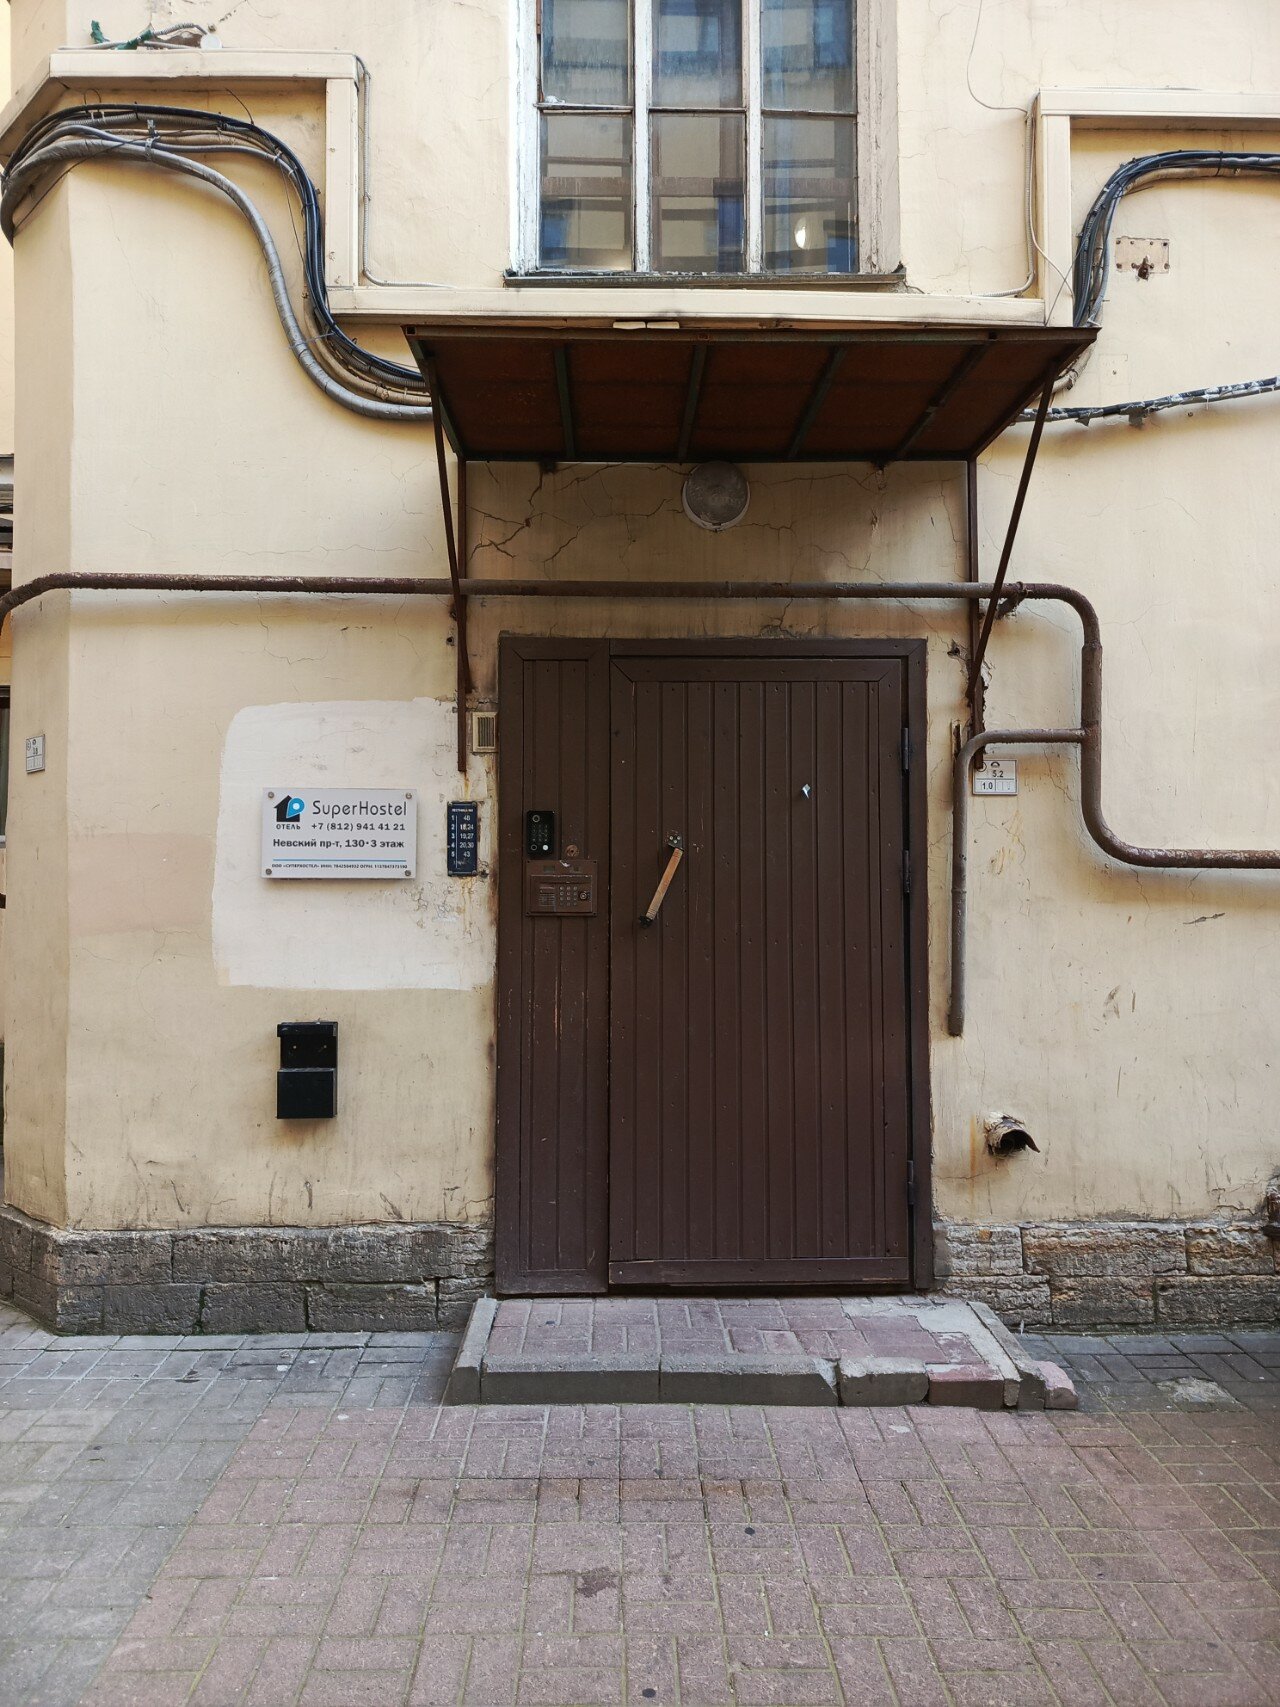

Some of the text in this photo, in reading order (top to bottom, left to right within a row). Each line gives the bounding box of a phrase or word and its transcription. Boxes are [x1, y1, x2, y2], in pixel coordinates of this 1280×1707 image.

[312, 800, 406, 818] SuperHostel
[326, 822, 354, 832] (812)
[273, 839, 316, 848] Невский
[320, 840, 342, 849] пр-т,
